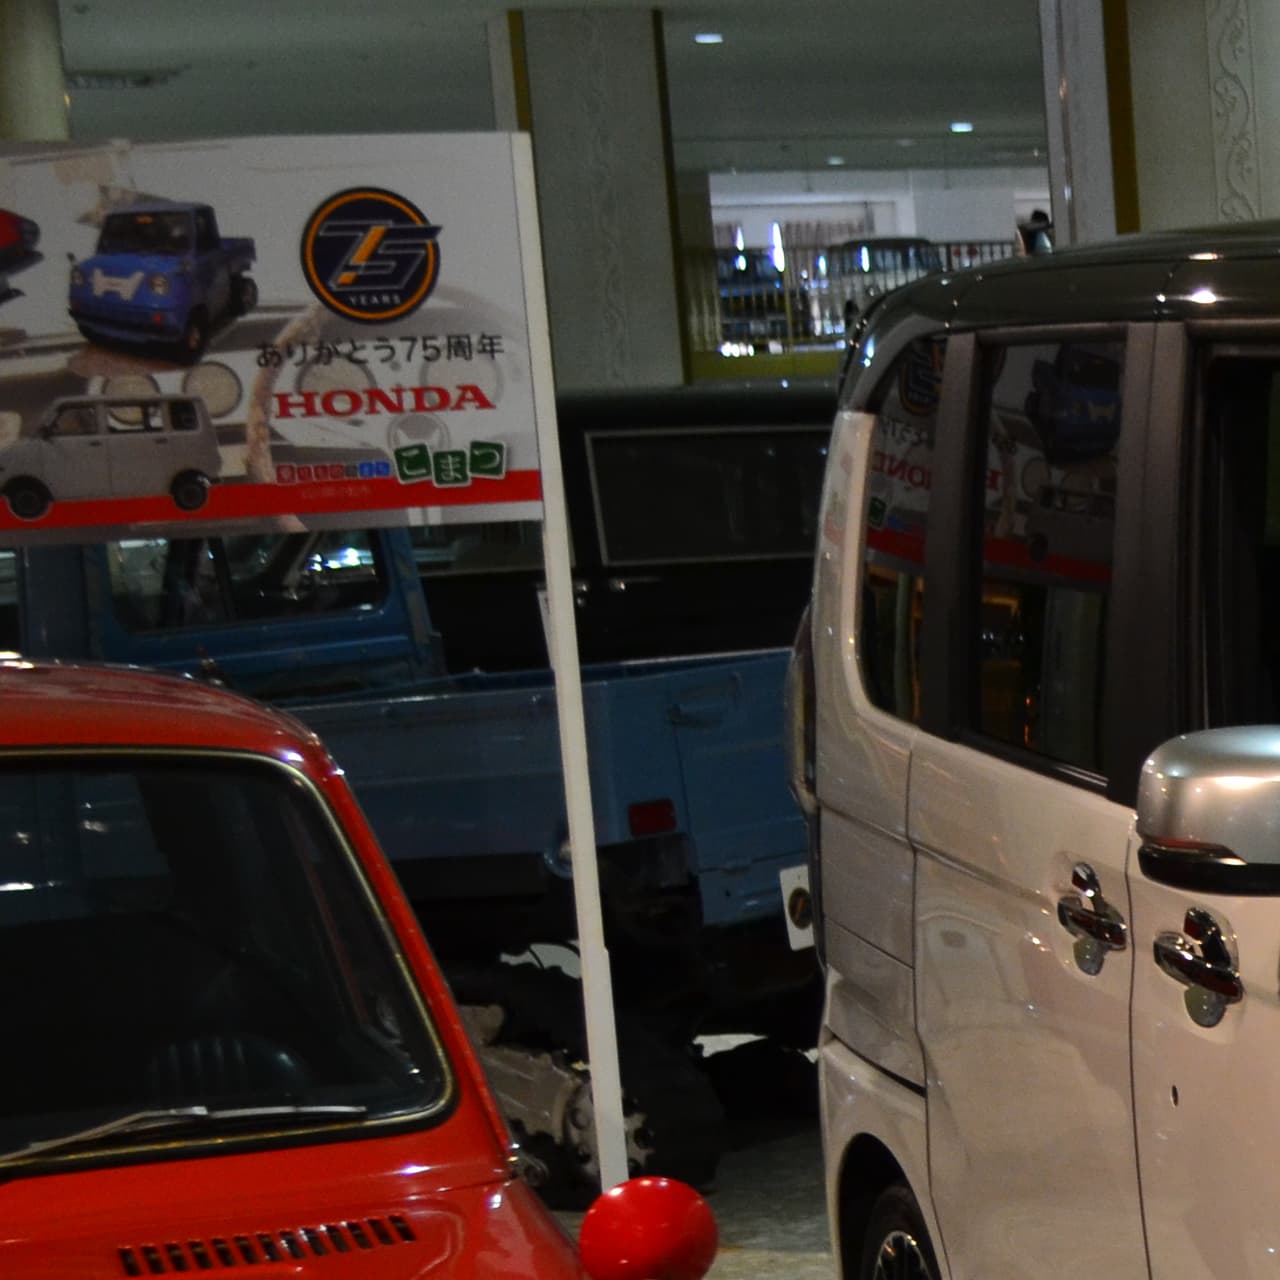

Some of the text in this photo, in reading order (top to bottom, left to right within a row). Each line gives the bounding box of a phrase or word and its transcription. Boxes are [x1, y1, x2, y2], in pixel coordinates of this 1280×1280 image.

[256, 332, 505, 368] ありがとう75周年
[273, 384, 497, 419] HONDA
[400, 447, 502, 482] こまつ
